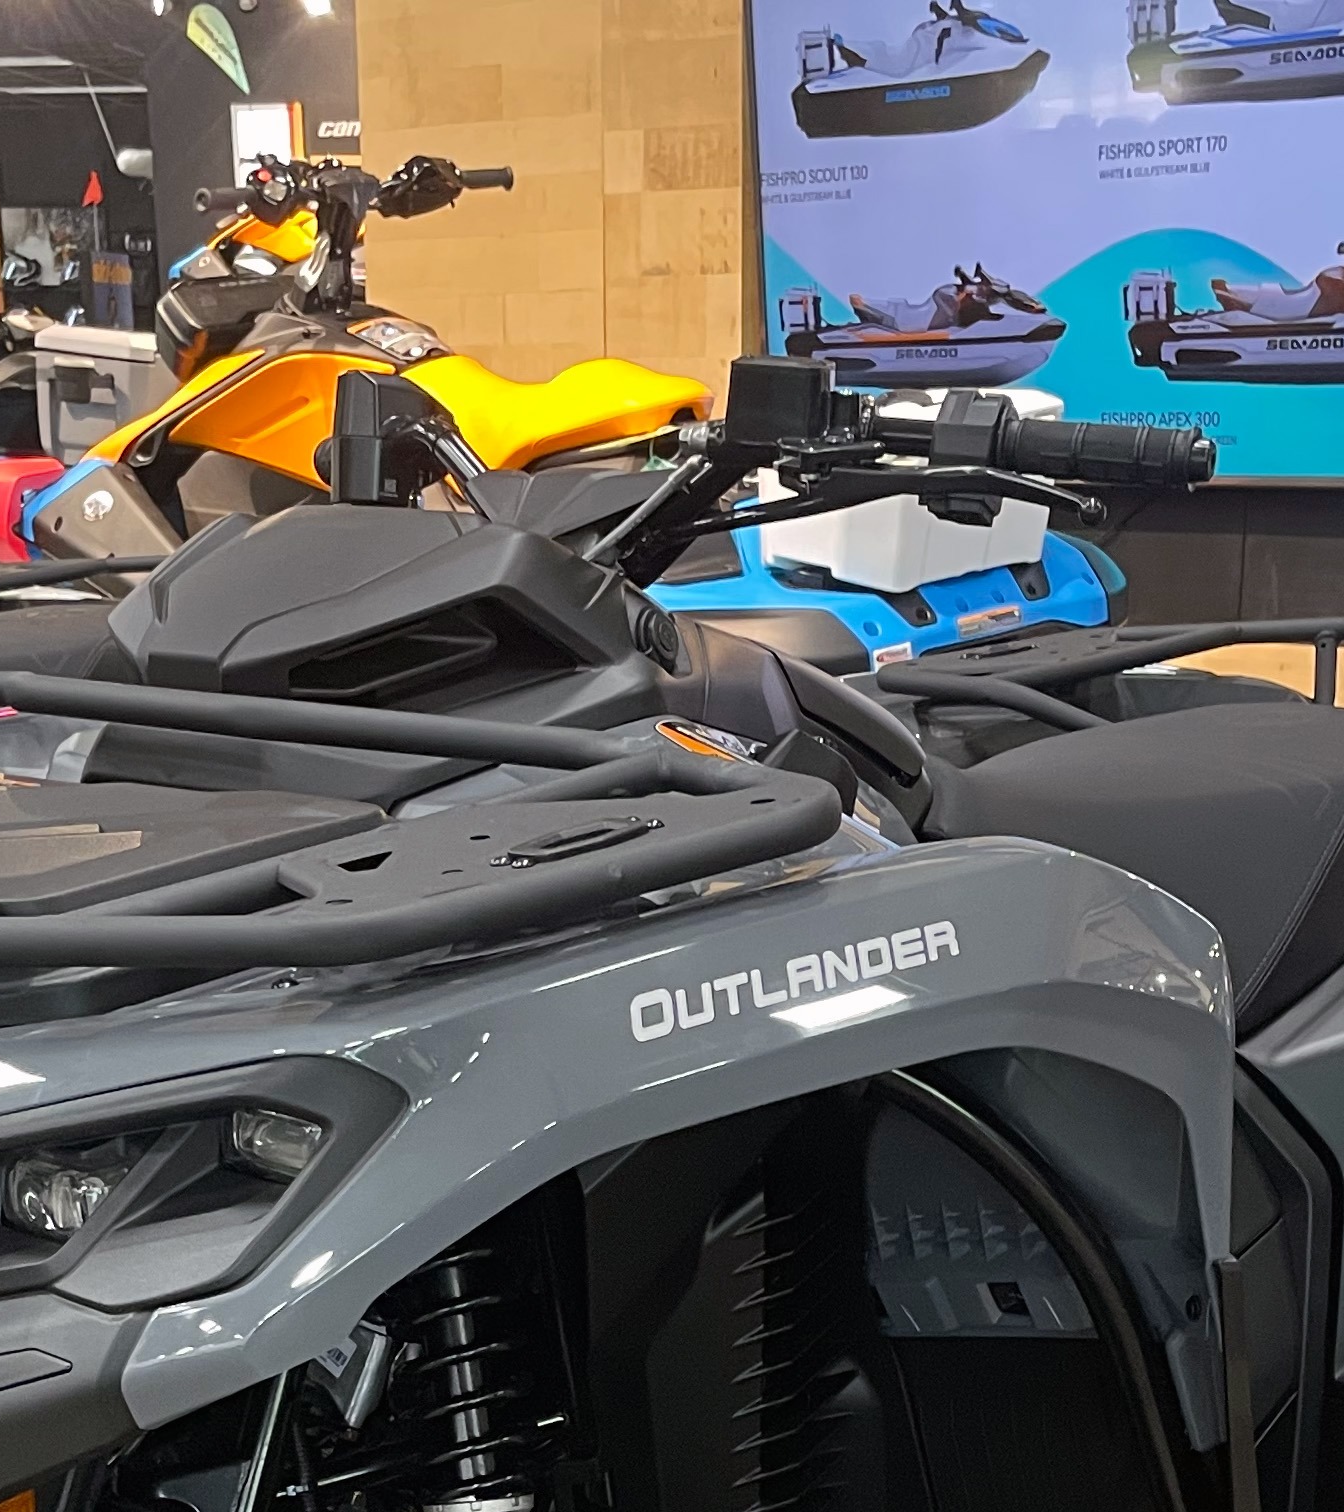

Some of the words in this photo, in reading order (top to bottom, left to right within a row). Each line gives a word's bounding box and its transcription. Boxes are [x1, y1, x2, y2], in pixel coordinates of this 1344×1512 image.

[1098, 140, 1156, 161] FISHPRO
[1158, 136, 1204, 157] SPORT
[1206, 134, 1228, 153] 170
[808, 166, 848, 184] SCOUT
[850, 164, 868, 181] 130
[1100, 411, 1157, 427] FISHPRO
[1158, 411, 1193, 428] APEX
[1194, 410, 1221, 428] 300
[629, 919, 960, 1043] OUTLANDER
